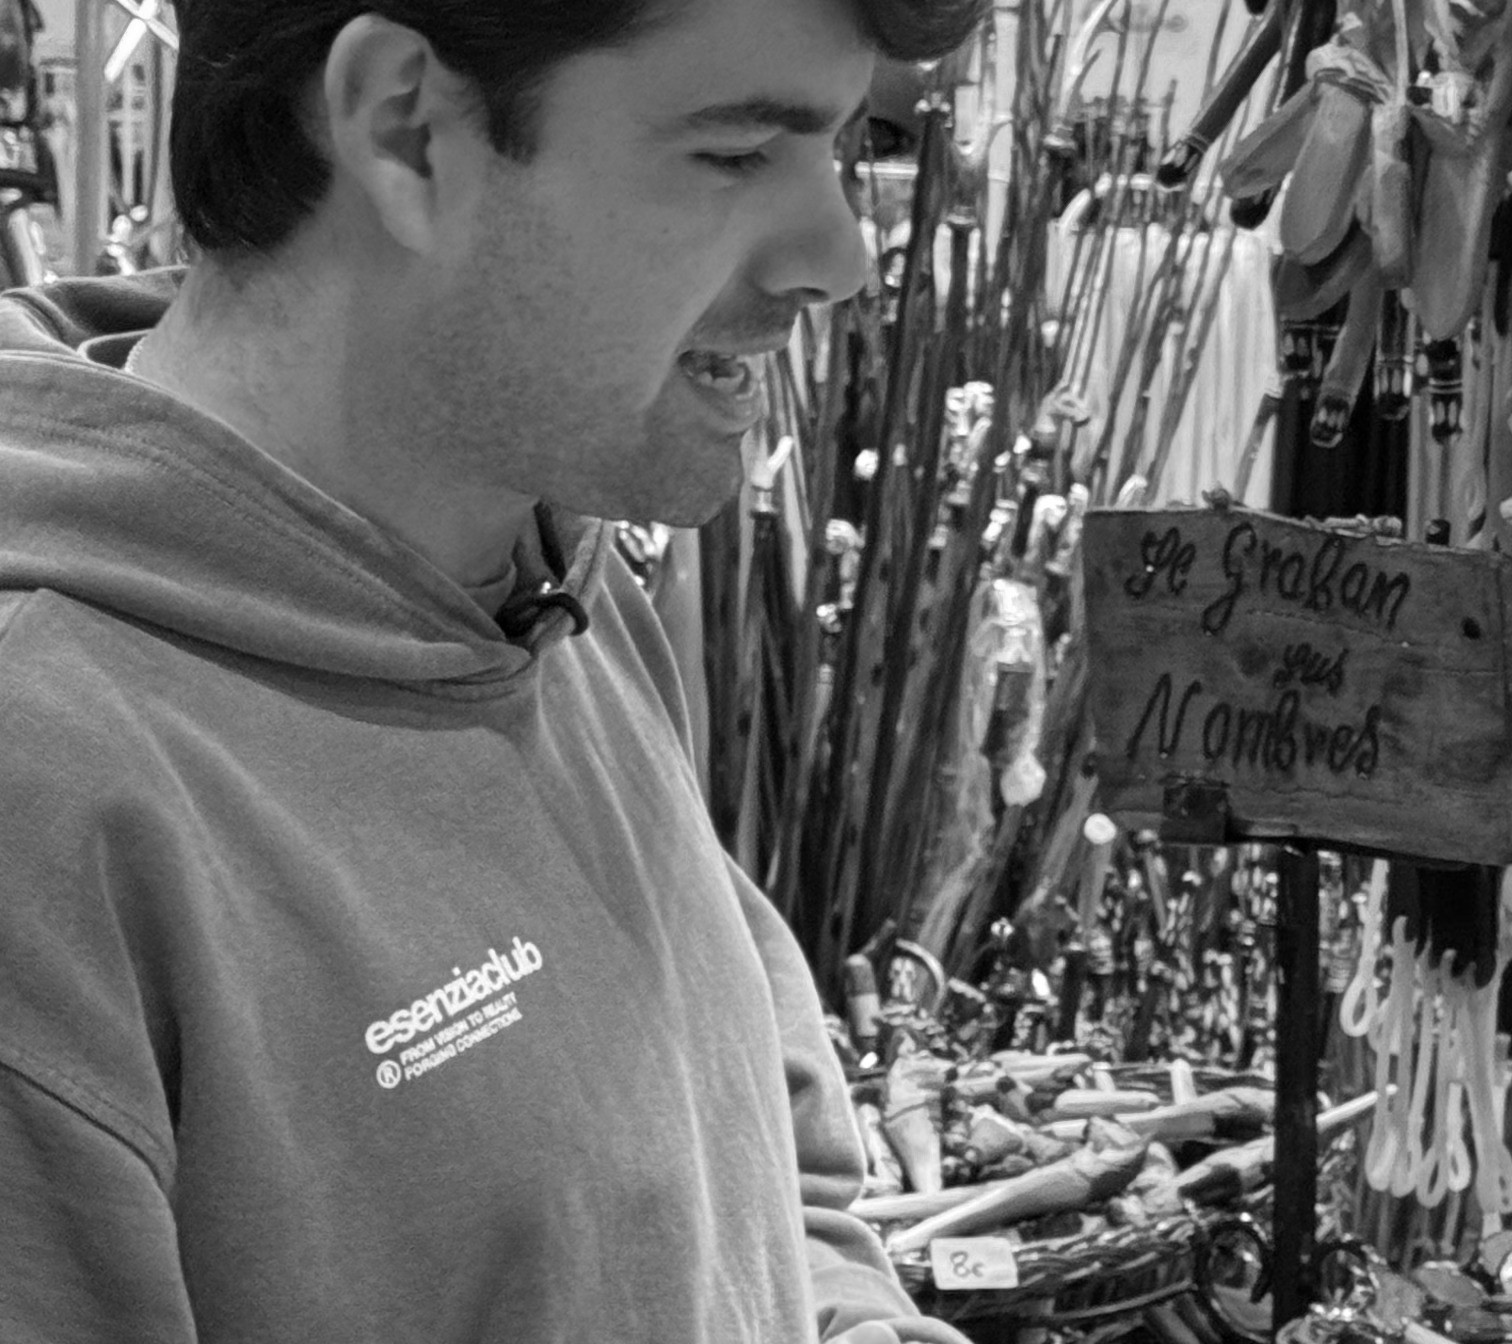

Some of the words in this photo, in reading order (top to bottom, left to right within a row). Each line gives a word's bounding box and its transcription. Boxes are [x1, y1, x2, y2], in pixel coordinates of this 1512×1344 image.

[1202, 521, 1410, 637] Graban
[1126, 671, 1381, 780] Nombres
[365, 935, 543, 1054] esenziaclub
[400, 1037, 436, 1066] FROM
[466, 1010, 484, 1027] TO
